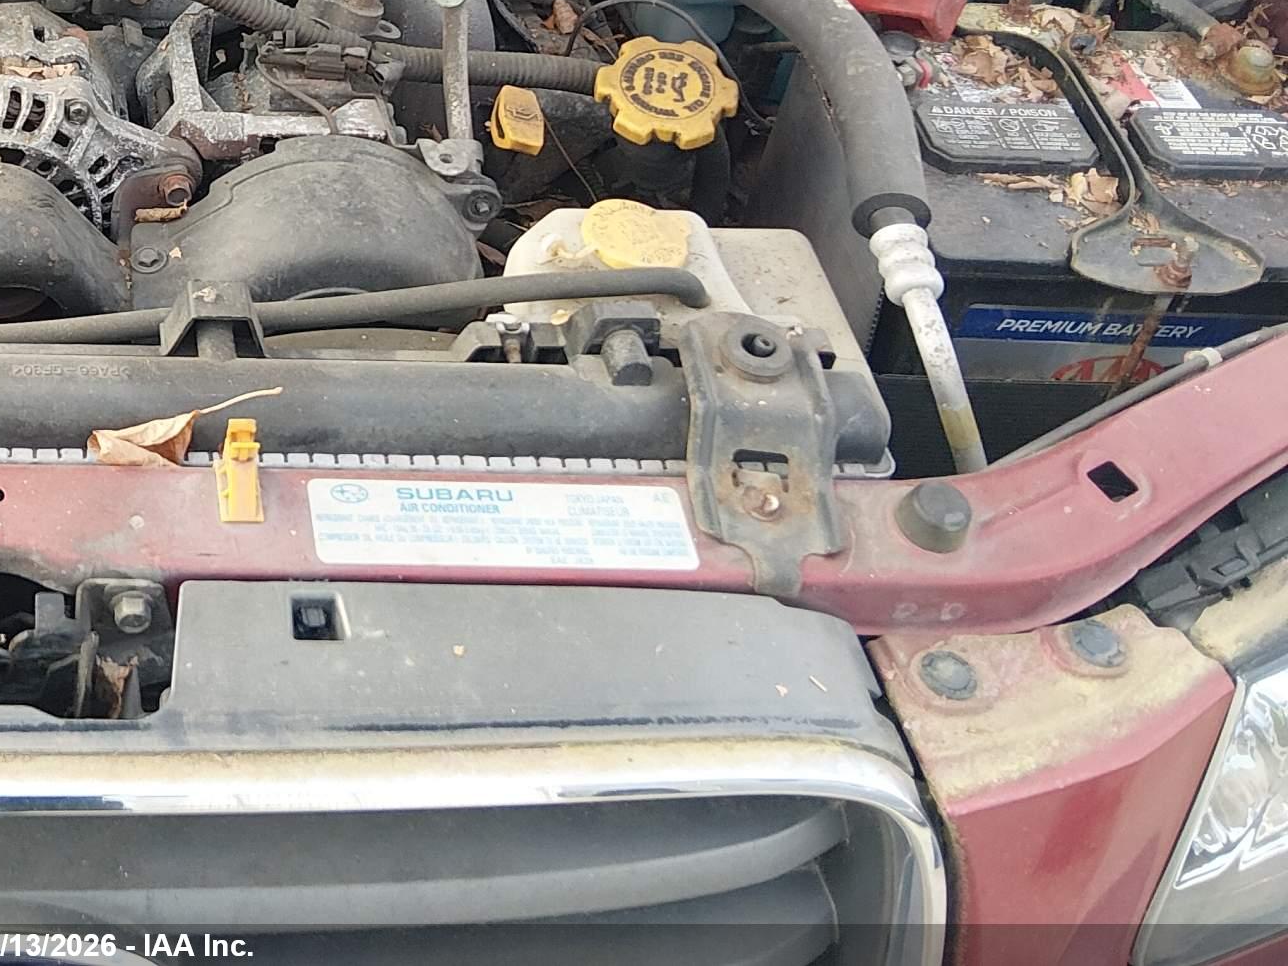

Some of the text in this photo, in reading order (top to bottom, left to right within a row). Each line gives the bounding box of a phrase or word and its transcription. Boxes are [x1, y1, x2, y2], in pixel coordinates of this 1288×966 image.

[943, 106, 998, 117] DANGER
[1009, 108, 1058, 118] POISON
[996, 318, 1104, 335] PREMIUM
[396, 487, 513, 502] SUBARU
[399, 502, 500, 514] AIR CONDITIONER
